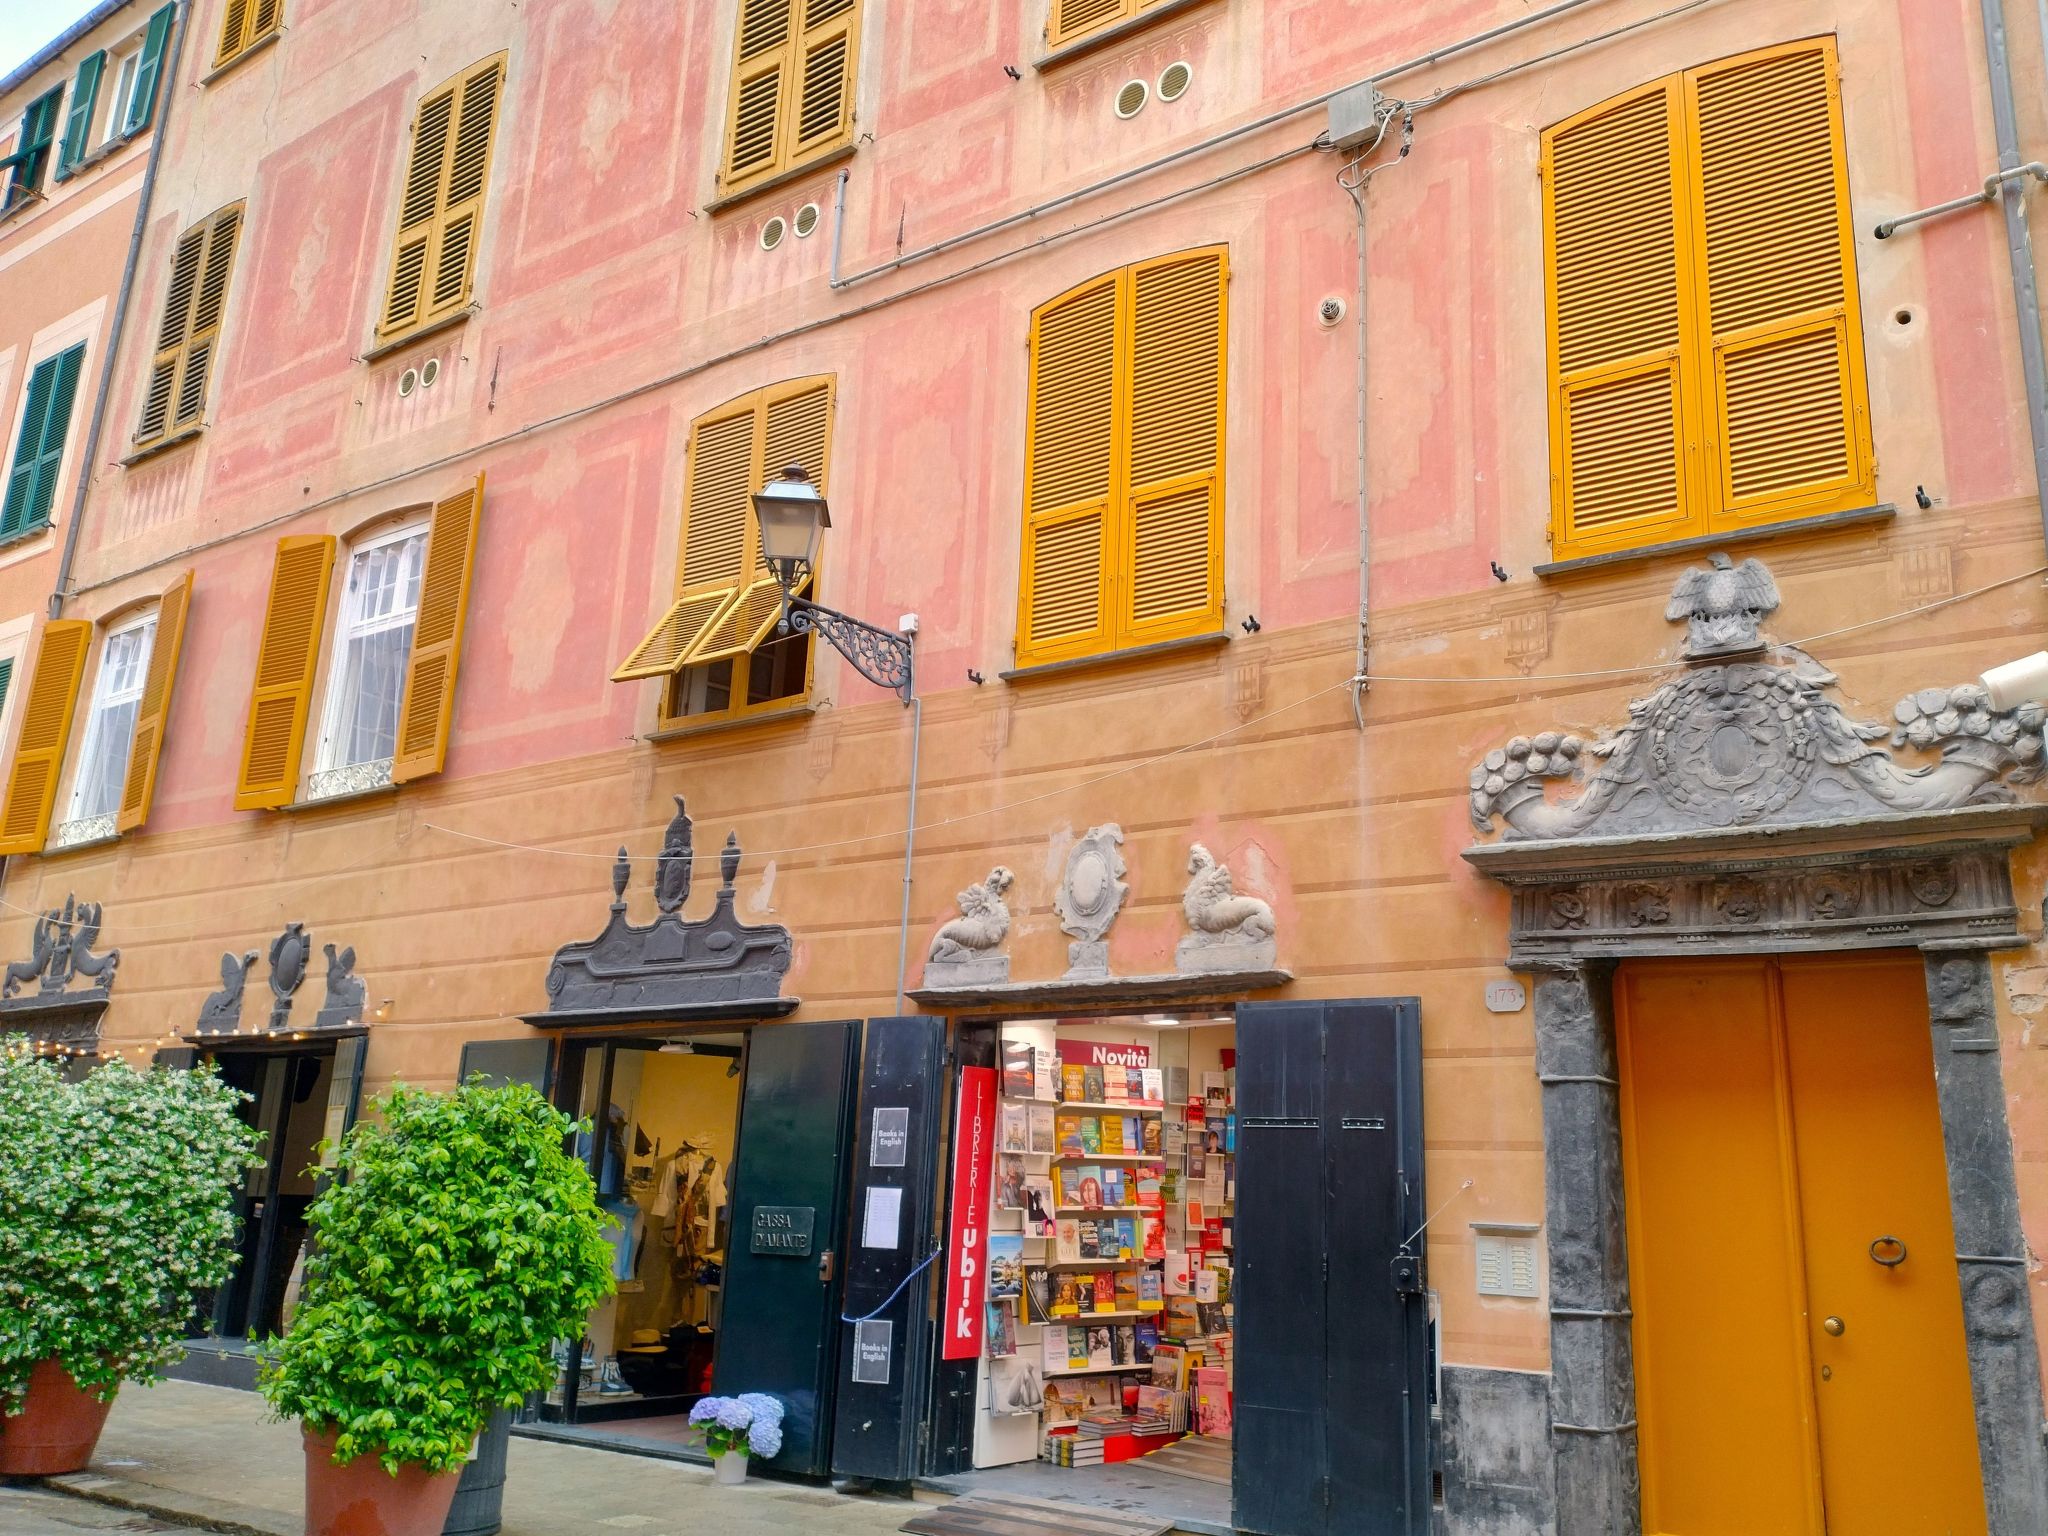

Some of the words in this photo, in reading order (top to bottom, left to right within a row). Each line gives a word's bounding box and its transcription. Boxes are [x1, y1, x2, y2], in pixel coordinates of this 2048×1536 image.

[1494, 988, 1517, 1003] 173
[1092, 1046, 1148, 1068] Novità
[878, 1129, 898, 1138] Books
[898, 1129, 905, 1138] in
[880, 1137, 902, 1147] English
[967, 1081, 982, 1225] LIBRERIE
[757, 1213, 792, 1228] GASSA
[956, 1228, 977, 1338] ubik
[861, 1343, 881, 1352] Books
[881, 1343, 888, 1352] in
[862, 1351, 886, 1361] English
